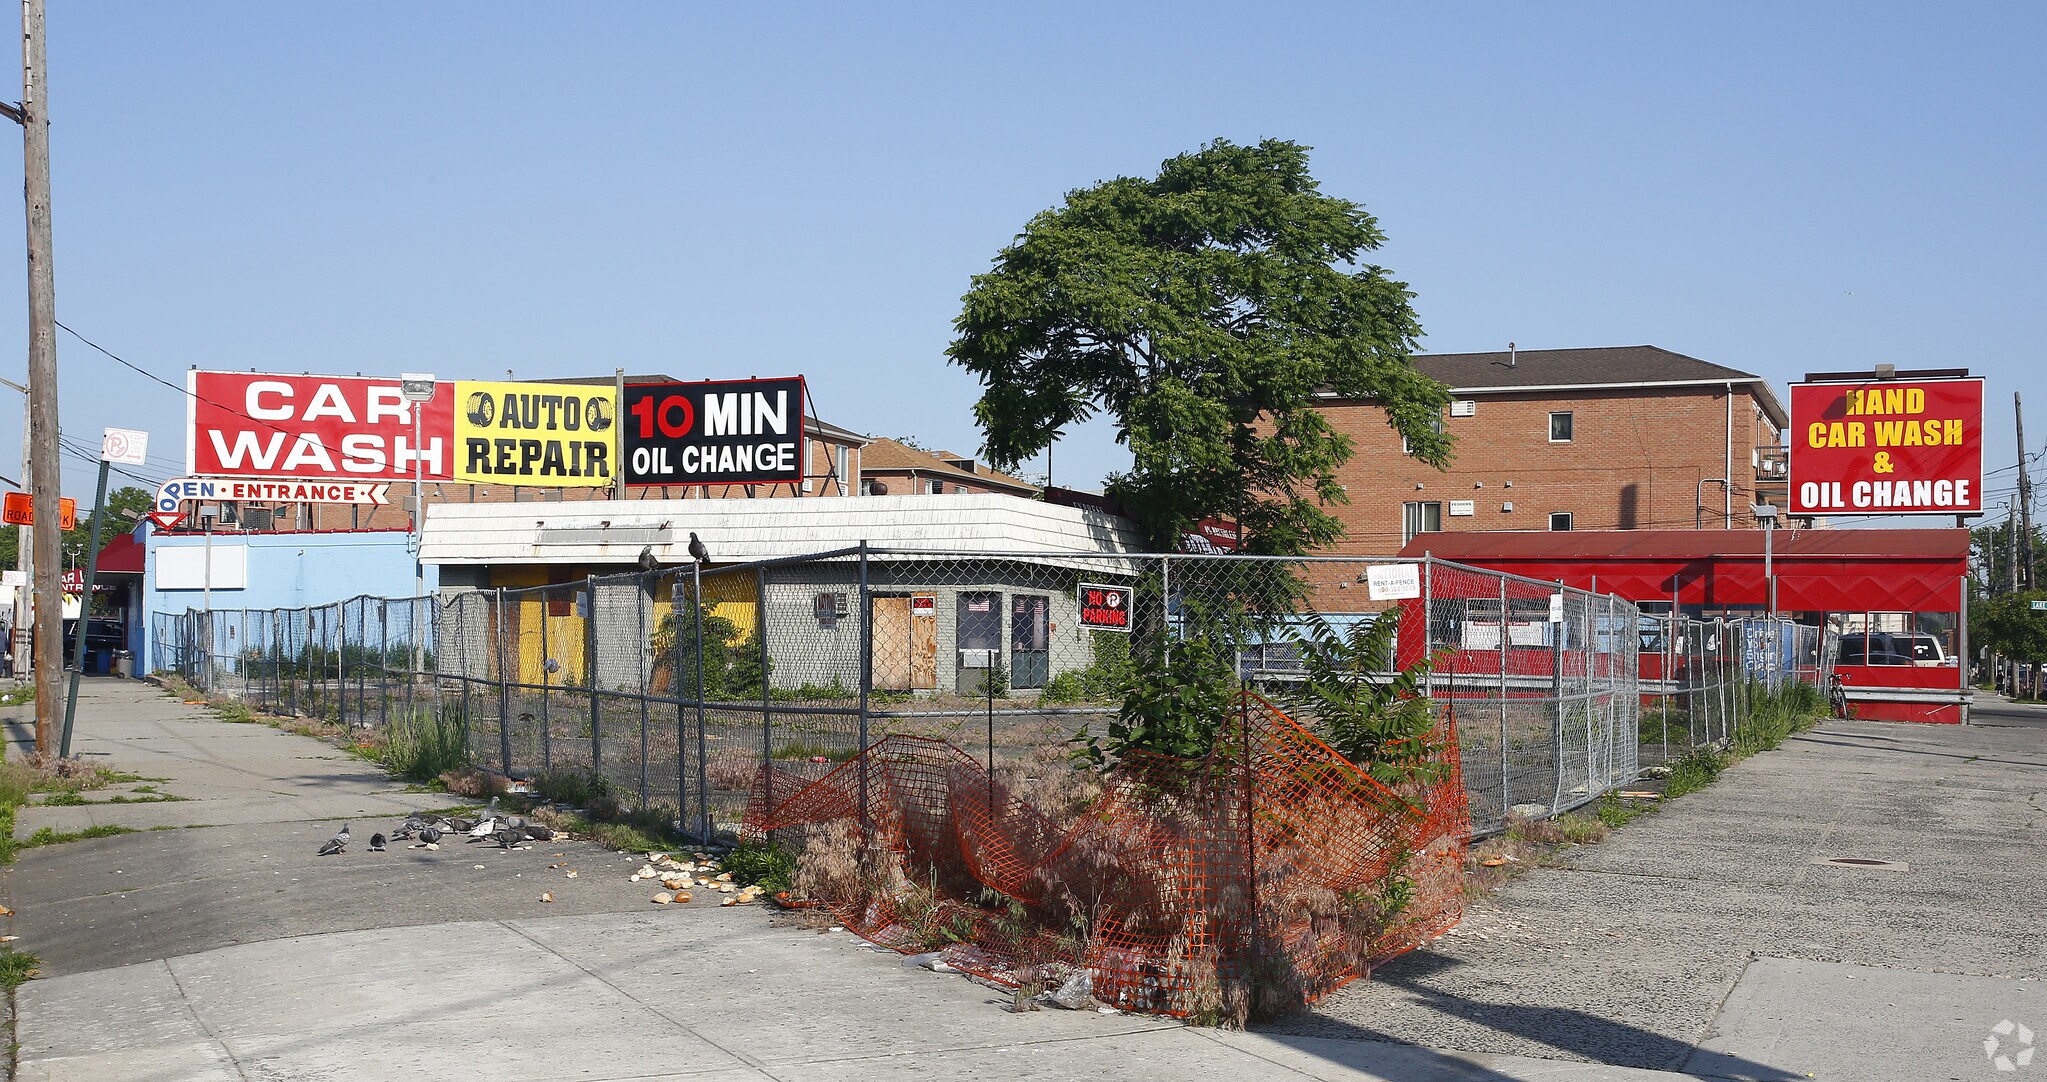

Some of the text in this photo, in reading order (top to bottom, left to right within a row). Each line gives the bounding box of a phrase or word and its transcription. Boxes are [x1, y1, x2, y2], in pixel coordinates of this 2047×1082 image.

[245, 380, 412, 425] CAR
[499, 393, 580, 431] AUTO
[631, 390, 788, 438] 10 MIN
[1846, 388, 1925, 416] HAND
[1808, 419, 1963, 448] CAR WASH
[207, 429, 443, 476] WASH
[466, 437, 610, 478] REPAIR
[632, 442, 795, 475] OIL CHANGE
[1873, 451, 1894, 474] &
[160, 482, 355, 511] OPEN ENTRANCE
[1800, 479, 1970, 508] OIL CHANGE
[62, 572, 75, 583] AR
[1373, 579, 1415, 587] RENT-A-FENCE
[1088, 590, 1103, 606] NO
[1083, 607, 1126, 625] PARKING
